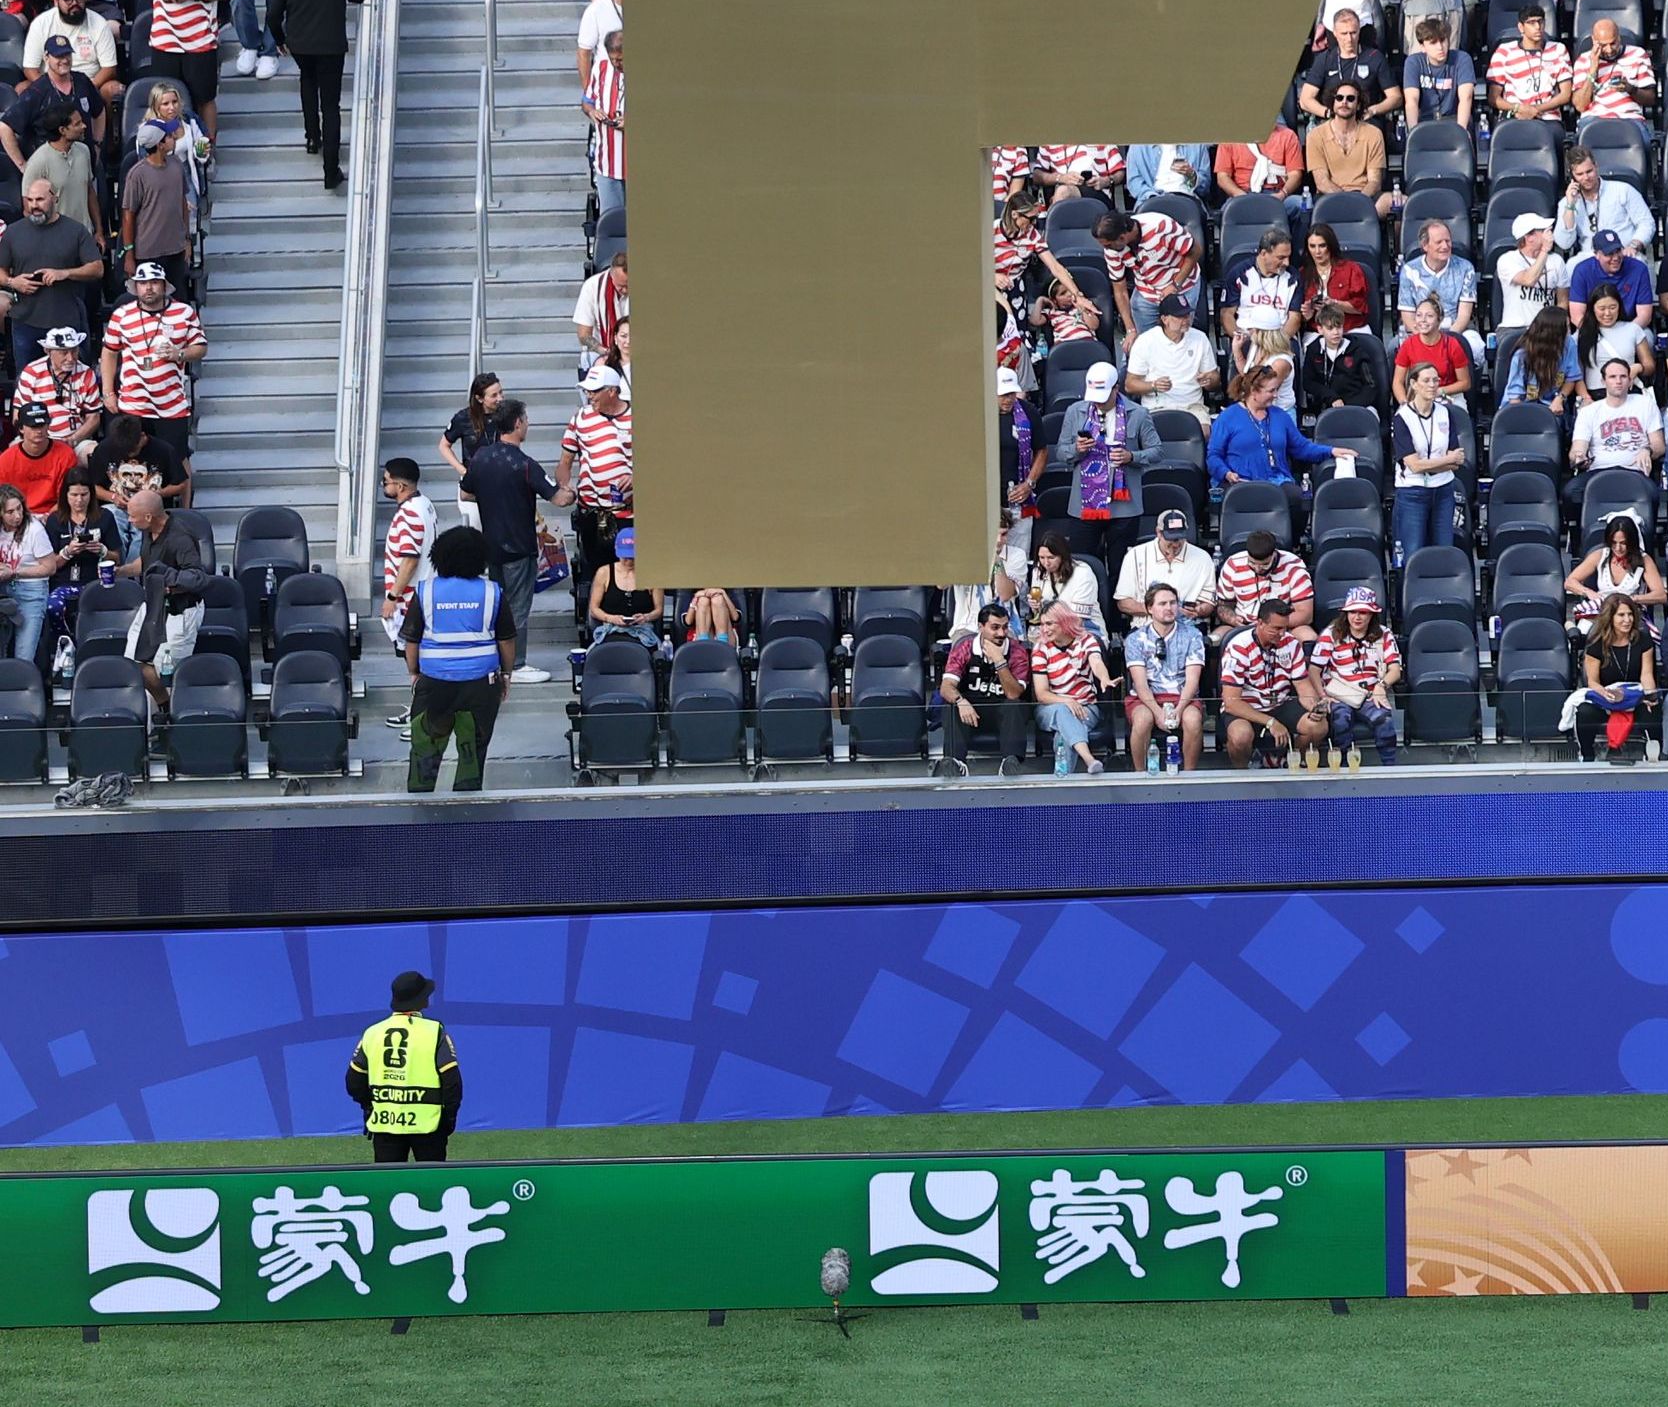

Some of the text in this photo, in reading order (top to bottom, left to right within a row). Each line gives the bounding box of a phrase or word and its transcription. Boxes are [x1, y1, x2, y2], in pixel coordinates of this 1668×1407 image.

[1250, 294, 1284, 306] USA
[437, 601, 480, 610] EVENT STAFF
[968, 677, 1005, 697] Jeep
[1029, 1168, 1286, 1289] 蒙牛
[251, 1185, 510, 1303] 蒙牛
